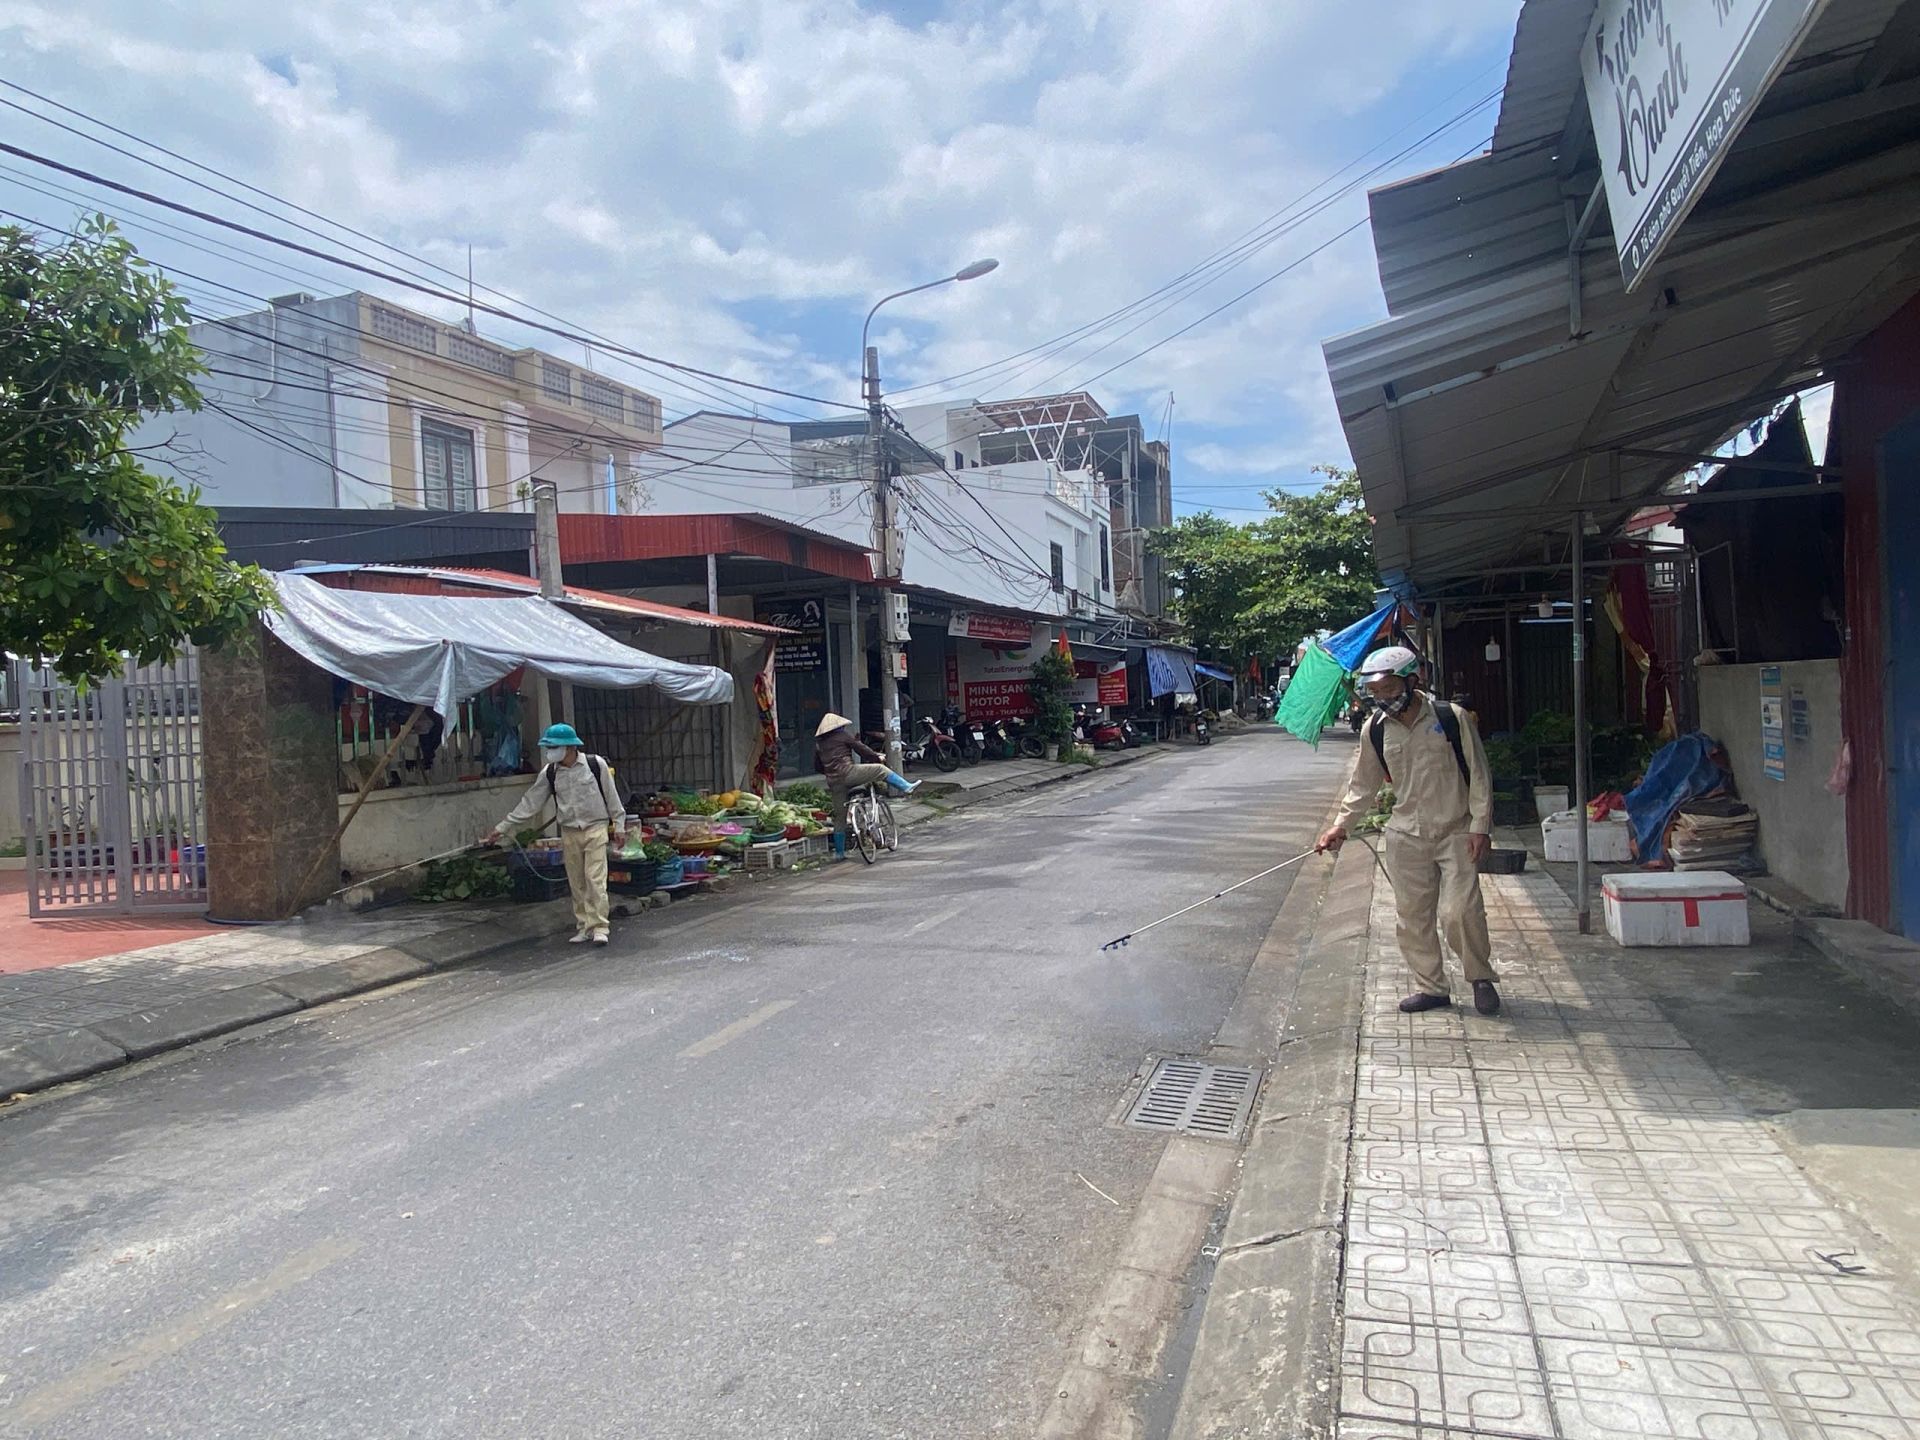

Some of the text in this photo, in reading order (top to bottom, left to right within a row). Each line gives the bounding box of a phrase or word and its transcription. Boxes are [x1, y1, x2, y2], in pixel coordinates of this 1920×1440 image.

[1617, 24, 1689, 197] Danh
[1671, 163, 1689, 206] Quyết
[1689, 142, 1708, 176] Tiến,
[1706, 116, 1724, 148] Hợp
[1722, 86, 1742, 122] Đức
[969, 685, 997, 696] MINH
[969, 696, 1010, 707] MOTOR
